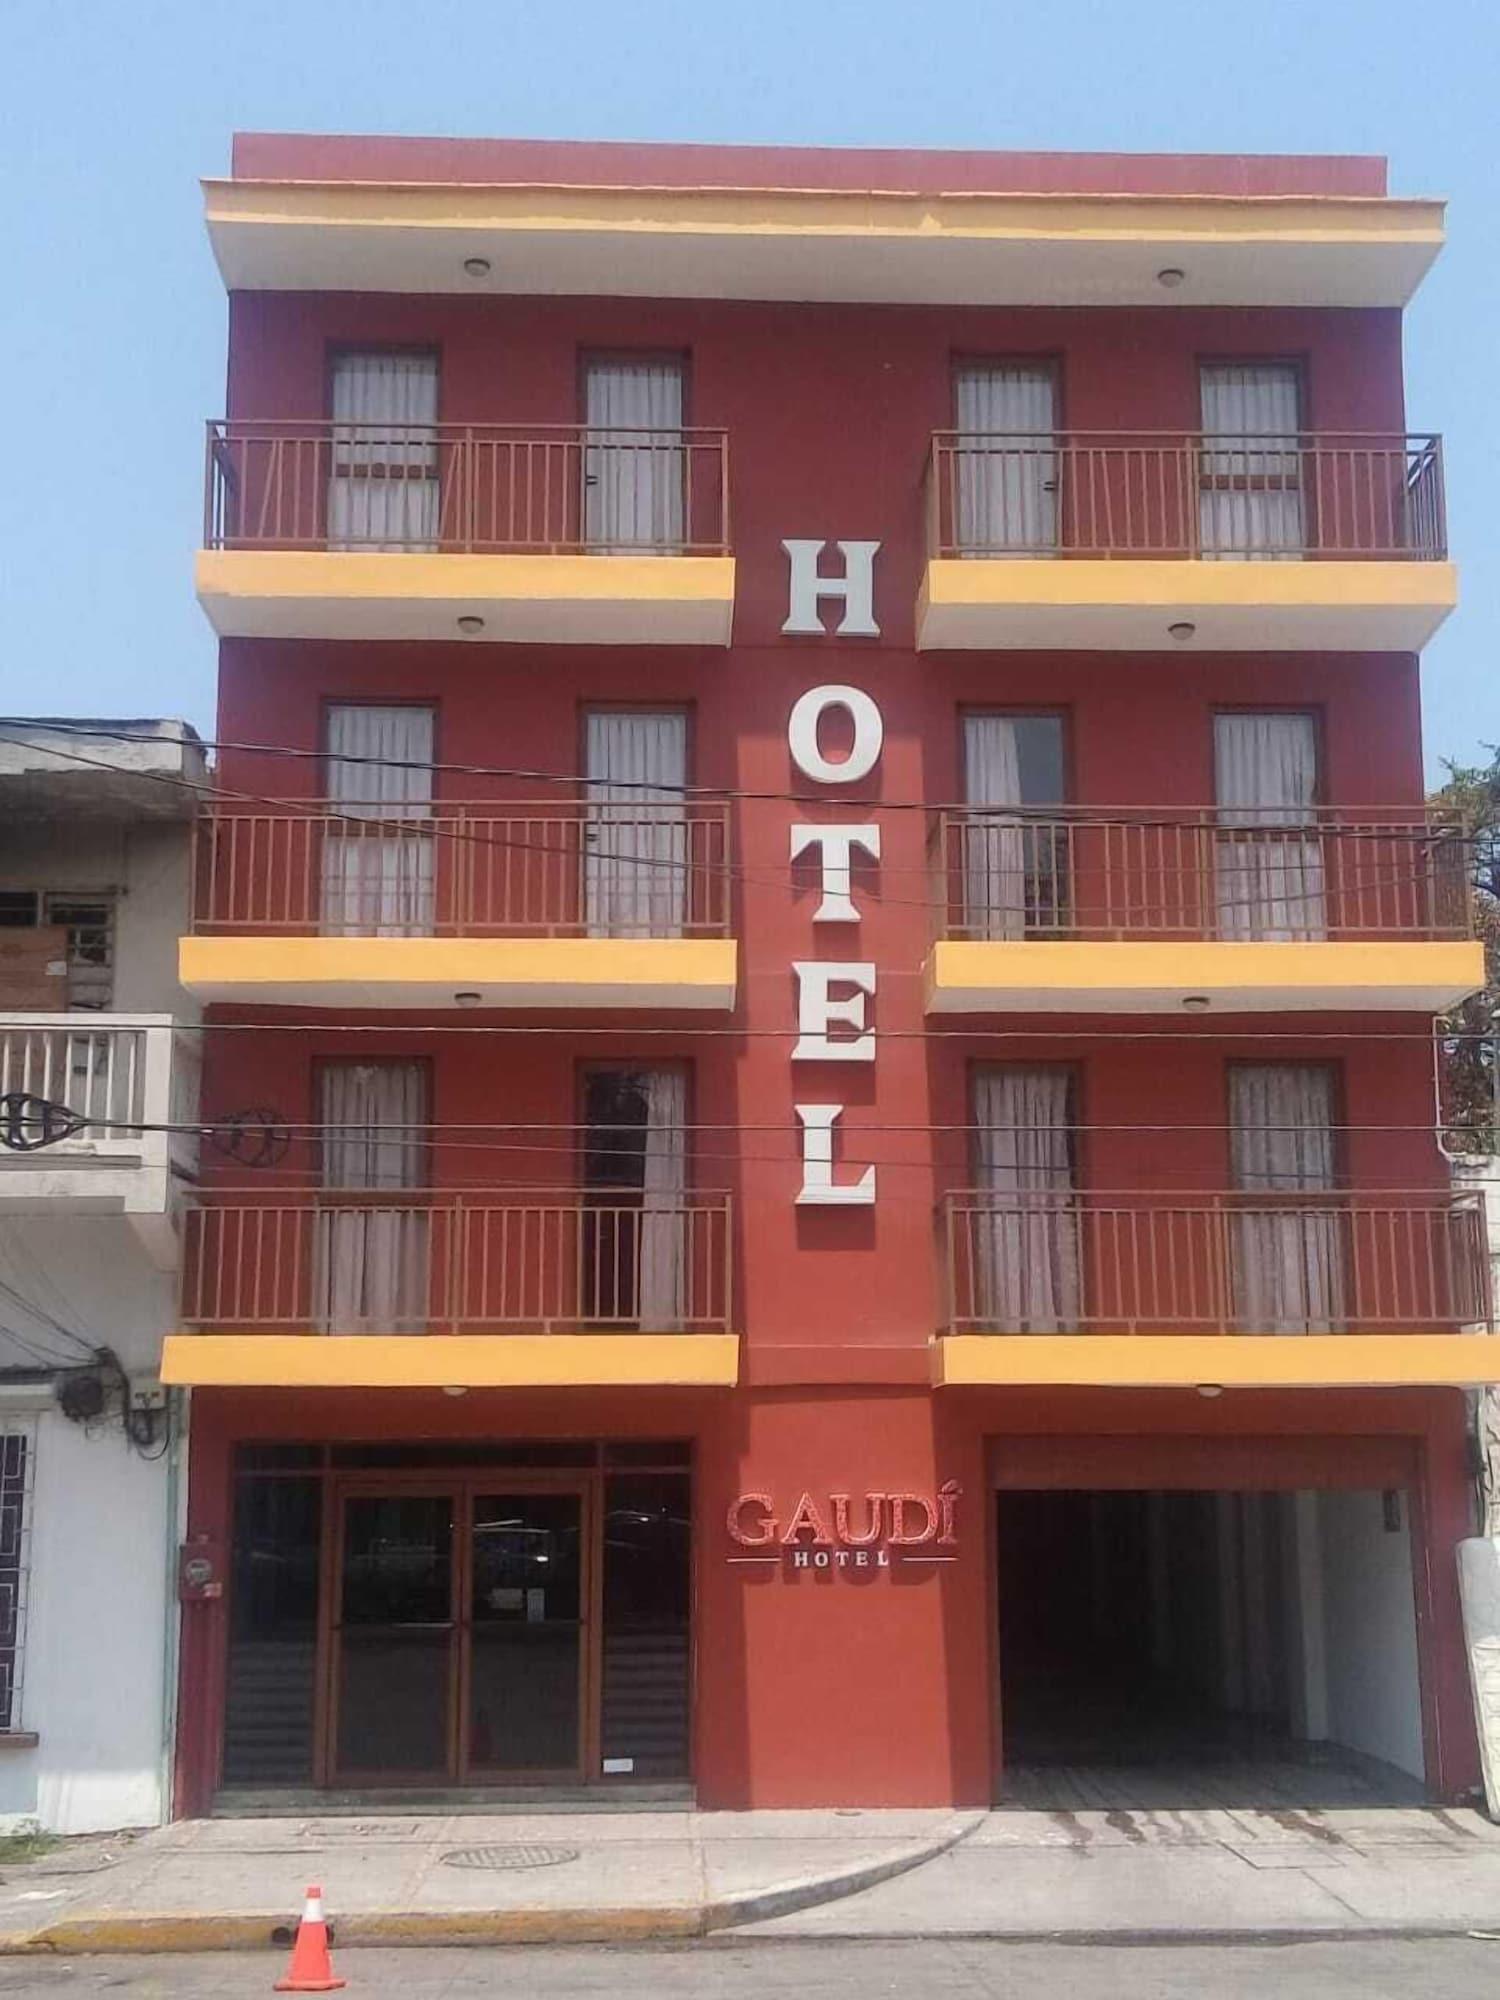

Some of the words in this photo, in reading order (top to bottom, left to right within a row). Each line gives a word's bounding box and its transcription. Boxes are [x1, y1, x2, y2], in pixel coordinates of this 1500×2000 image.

[780, 539, 883, 1205] HOTEL
[726, 1479, 963, 1546] GAUDÍ
[793, 1551, 889, 1567] HOTEL
